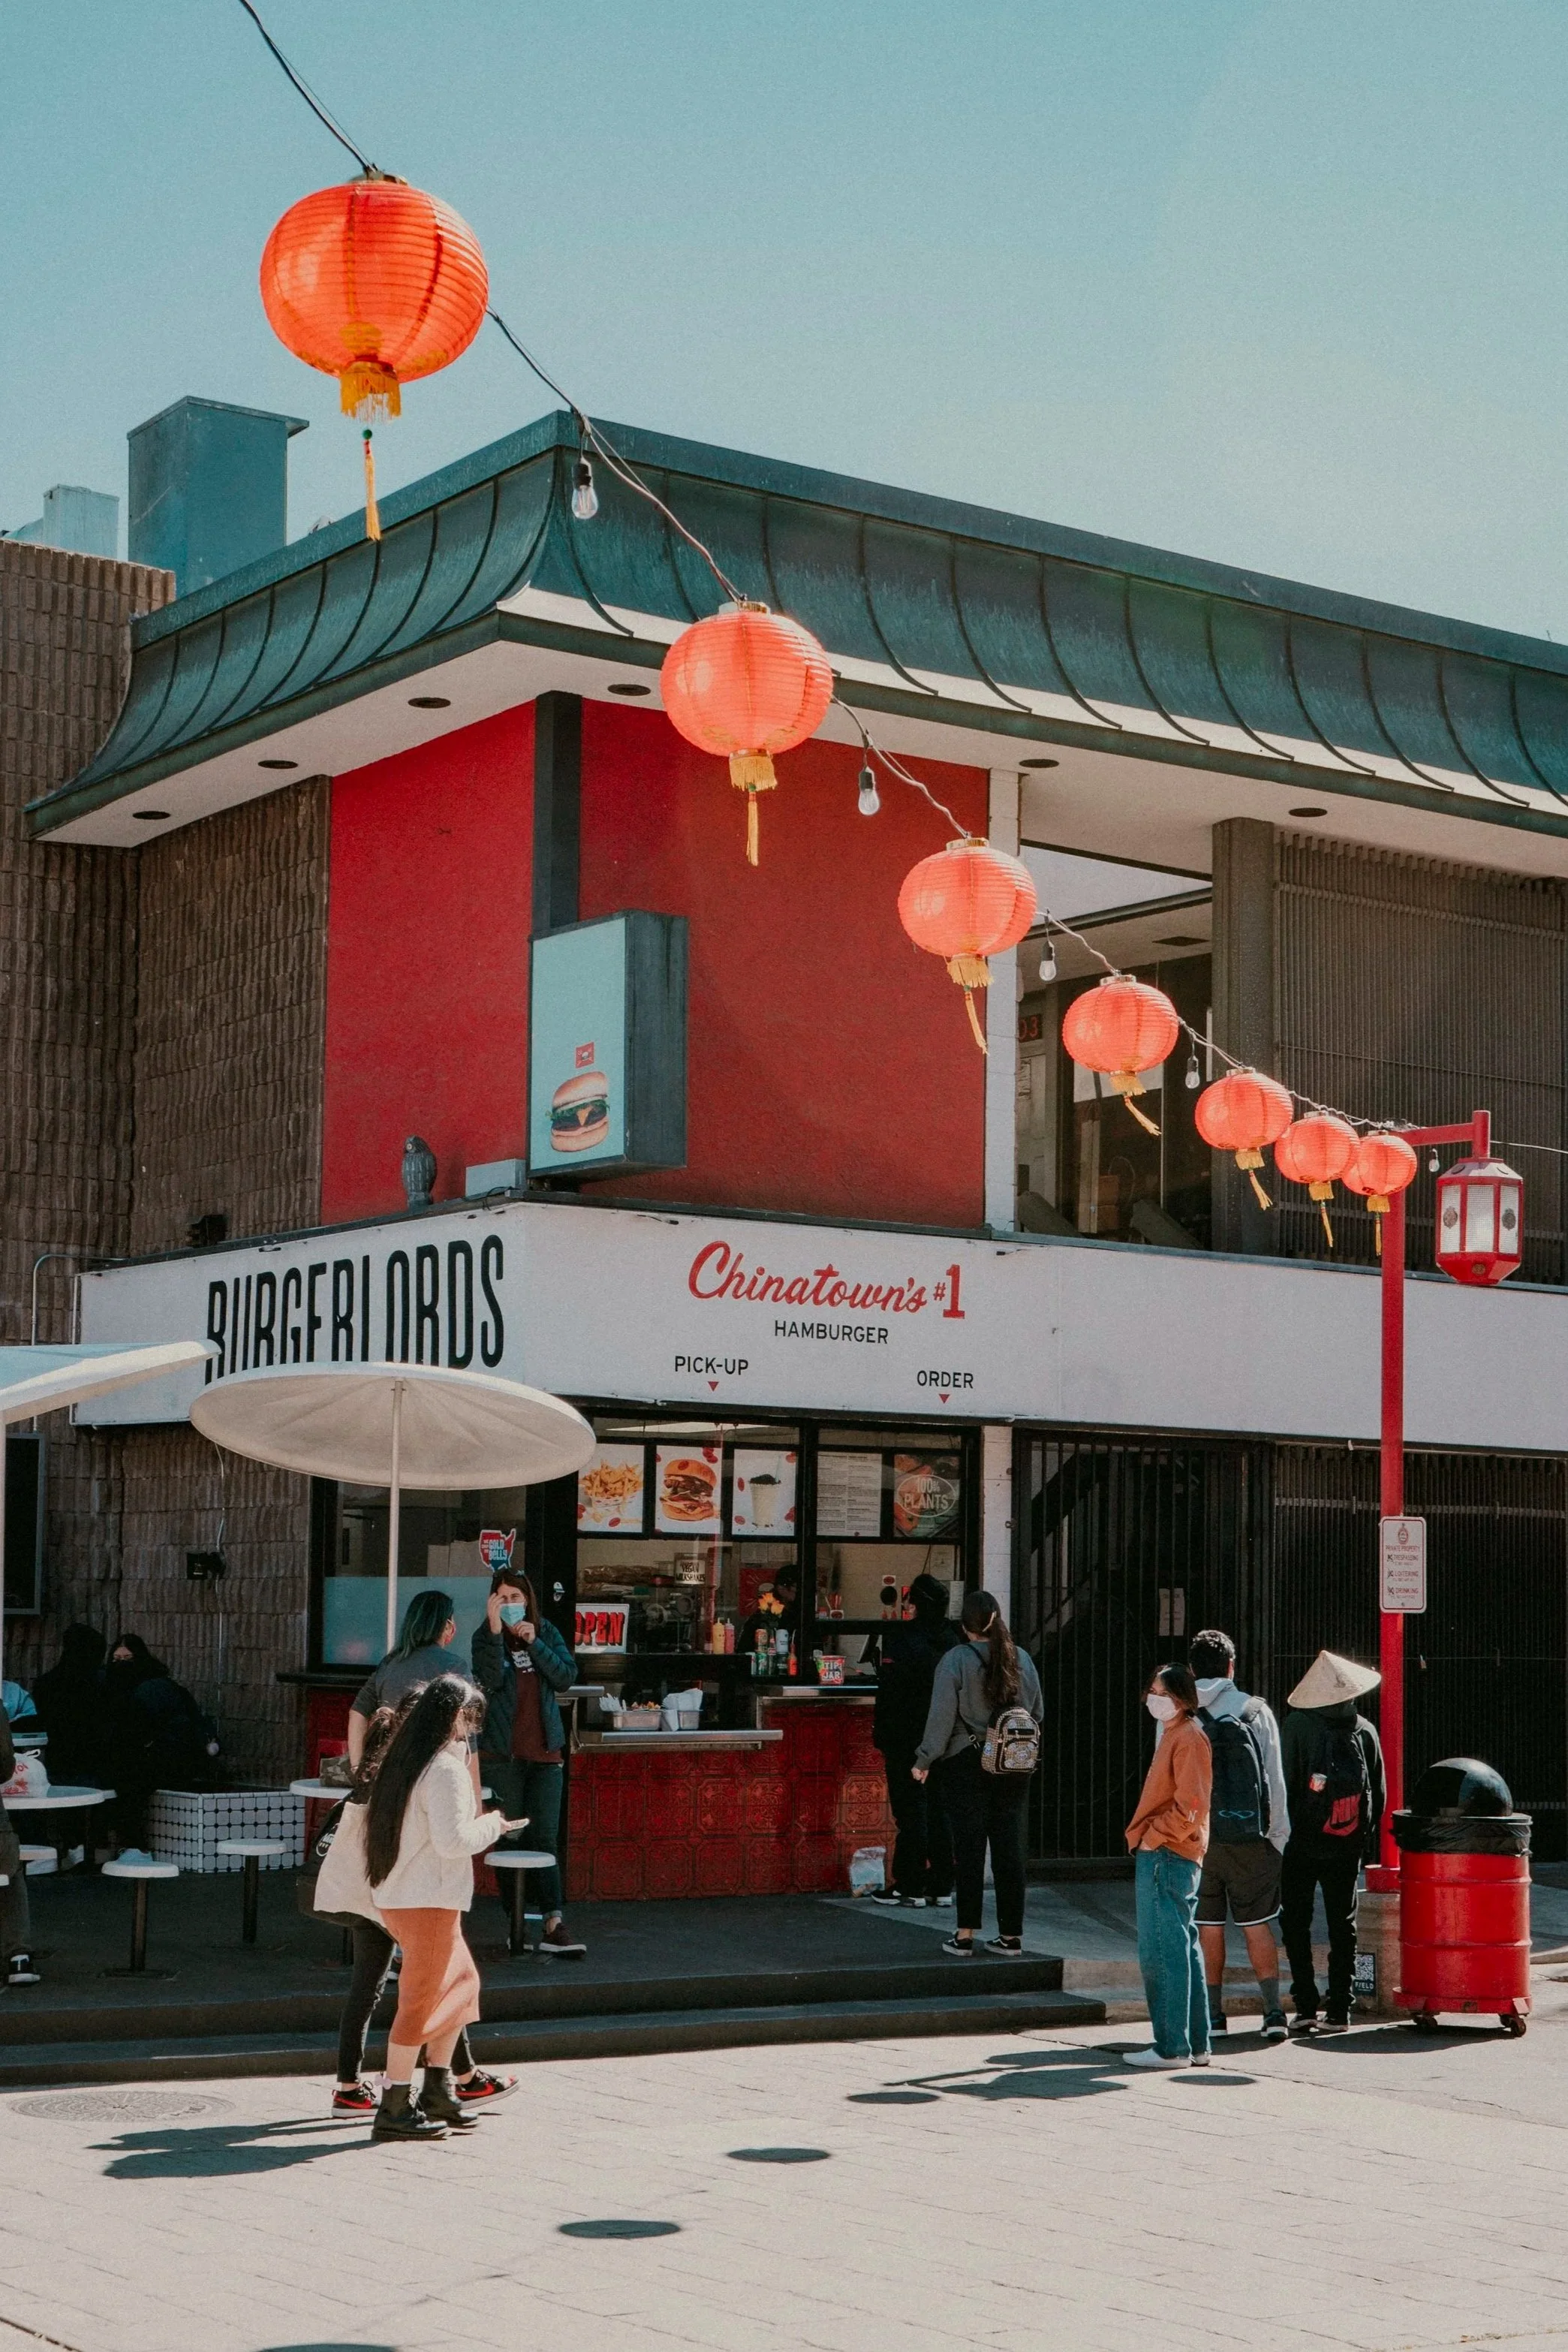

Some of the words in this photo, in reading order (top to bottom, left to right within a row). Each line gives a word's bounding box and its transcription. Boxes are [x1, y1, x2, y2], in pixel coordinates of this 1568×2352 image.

[688, 1240, 928, 1314] Chinatown's
[933, 1263, 966, 1320] #1
[774, 1320, 889, 1345] HAMBURGER
[675, 1356, 749, 1375] PICK-UP
[916, 1370, 974, 1389] ORDER
[917, 1477, 940, 1493] 100%
[904, 1492, 949, 1510] PLANTS
[824, 1671, 841, 1679] JAR
